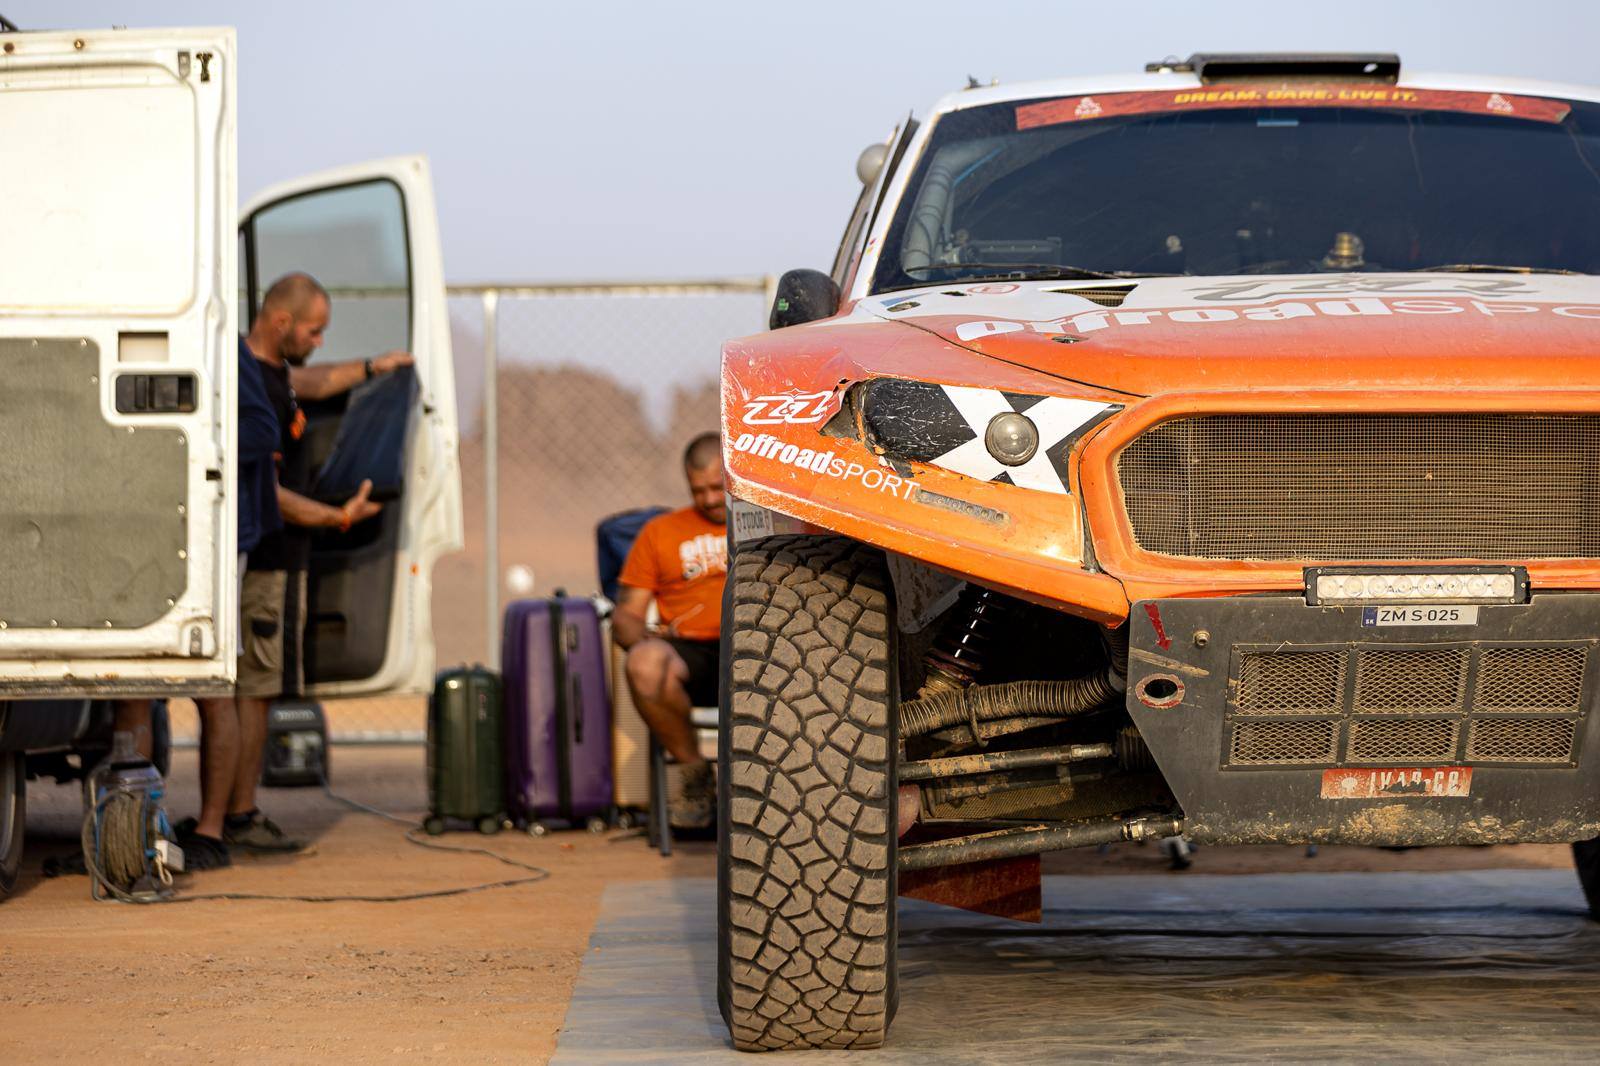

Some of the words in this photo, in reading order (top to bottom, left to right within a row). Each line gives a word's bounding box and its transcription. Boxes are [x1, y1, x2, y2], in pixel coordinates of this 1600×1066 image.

[1174, 91, 1262, 103] DREAM.
[1266, 90, 1334, 100] DARE.
[1338, 90, 1388, 100] LIVE
[1392, 91, 1418, 102] IT.
[734, 433, 920, 500] offroadSPORT
[741, 510, 765, 530] TUDOR
[1380, 610, 1406, 622] ZM
[1411, 609, 1423, 622] S
[1427, 609, 1459, 621] 025
